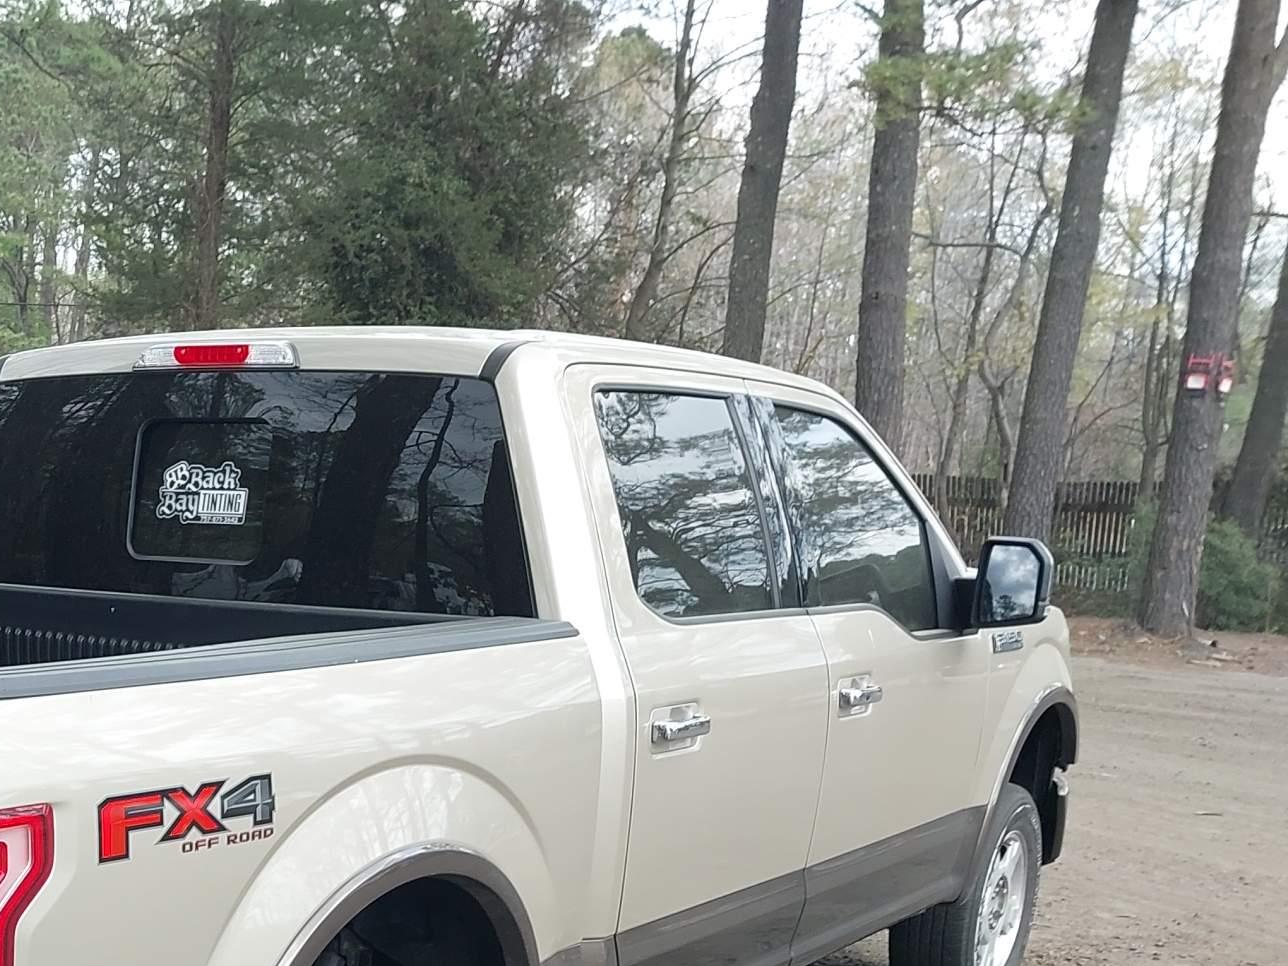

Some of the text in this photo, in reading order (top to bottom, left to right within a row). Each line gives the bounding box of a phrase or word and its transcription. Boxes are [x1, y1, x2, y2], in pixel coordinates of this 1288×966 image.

[187, 466, 236, 491] Back
[160, 492, 242, 519] Bay TINTING
[97, 771, 277, 865] FX4
[181, 827, 275, 854] OFF ROAD
